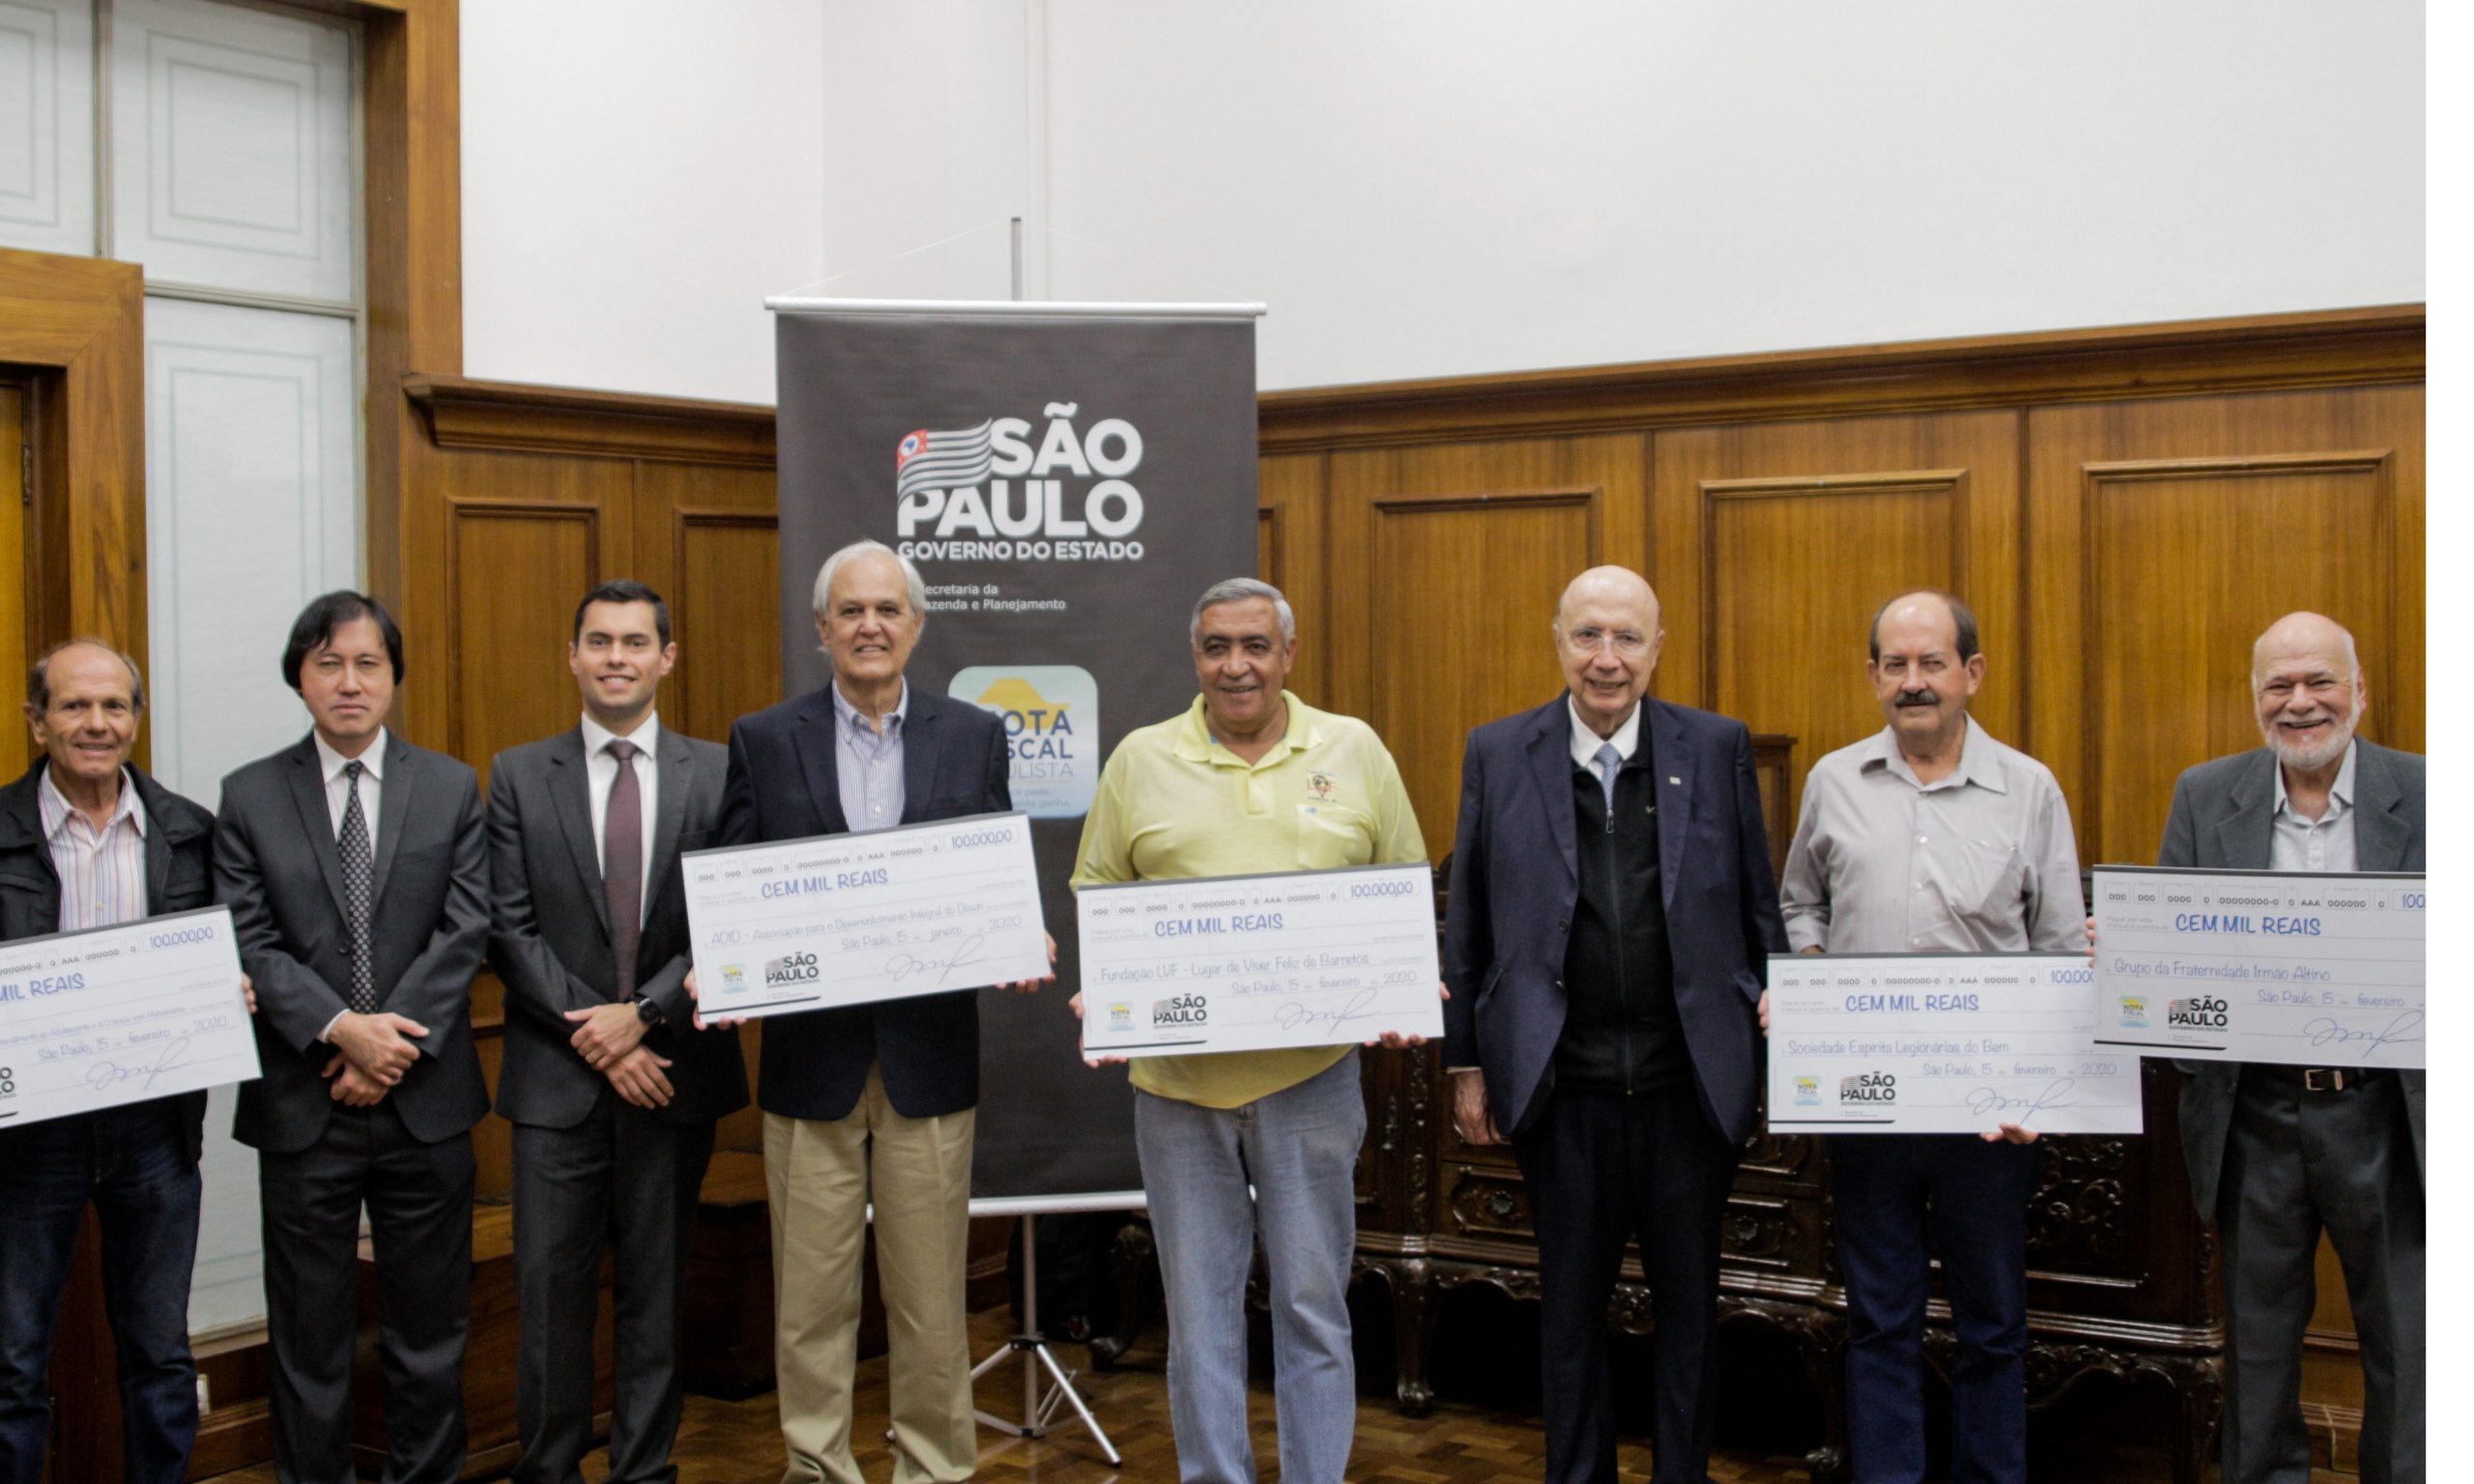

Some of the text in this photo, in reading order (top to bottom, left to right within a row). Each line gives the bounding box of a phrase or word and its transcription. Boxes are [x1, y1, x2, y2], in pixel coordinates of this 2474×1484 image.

[990, 402, 1144, 477] SÃO
[897, 479, 1144, 538] PAULO
[897, 541, 1144, 560] GOVERNO DO ESTADO
[924, 584, 998, 595] ecretaria da
[924, 599, 1066, 612] azenda e Planejamento
[1003, 709, 1073, 736] OTA
[951, 829, 1013, 850] 100.000,00
[762, 877, 799, 899] CEM
[803, 875, 833, 893] MIL
[837, 868, 888, 889] REAIS
[1351, 881, 1413, 898] 100.000,00
[957, 900, 984, 912] Down
[841, 937, 860, 951] São
[929, 926, 963, 943] janeiro
[988, 914, 1021, 930] 2020
[1154, 918, 1193, 937] CEM
[1196, 916, 1227, 934] MIL
[1231, 912, 1283, 931] REAIS
[2175, 914, 2219, 932] CEM
[2223, 914, 2257, 933] MIL
[2261, 916, 2321, 936] REAIS
[149, 926, 214, 951] 100.000,00
[783, 951, 818, 968] SÃO
[1101, 968, 1154, 982] Fundação
[1191, 962, 1223, 980] Lugar
[1226, 960, 1241, 974] de
[1243, 958, 1271, 973] Viver
[1276, 956, 1301, 970] Feliz
[1305, 955, 1316, 968] de
[1320, 953, 1369, 968] Barretos
[765, 966, 820, 984] PAULO
[2114, 958, 2331, 982] Grupo da Fraternidade Irmão Altino
[29, 972, 85, 997] REAIS
[1231, 982, 1251, 995] São
[1288, 978, 1300, 991] 15
[1319, 976, 1361, 989] fevereiro
[1383, 970, 1417, 985] 2020
[1171, 993, 1206, 1010] SÃO
[1846, 995, 1884, 1013] CEM
[1889, 995, 1919, 1013] MIL
[1925, 994, 1979, 1011] REAIS
[2190, 995, 2229, 1013] SÃO
[2258, 988, 2405, 1007] São Paulo, 15 fevereiro
[1154, 1009, 1207, 1024] PAULO
[2169, 1013, 2229, 1027] PAULO
[38, 1047, 58, 1061] São
[129, 1028, 170, 1044] fevereiro
[193, 1015, 228, 1033] 2020
[1788, 1040, 1846, 1055] Sociedade
[1965, 1039, 1979, 1053] do
[1983, 1039, 2010, 1053] Bem
[1859, 1070, 1896, 1088] SÃO
[1923, 1064, 1942, 1076] São
[1981, 1063, 1993, 1075] 15
[2014, 1063, 2057, 1076] fevereiro
[2082, 1063, 2117, 1076] 2020
[1840, 1088, 1896, 1101] PAULO
